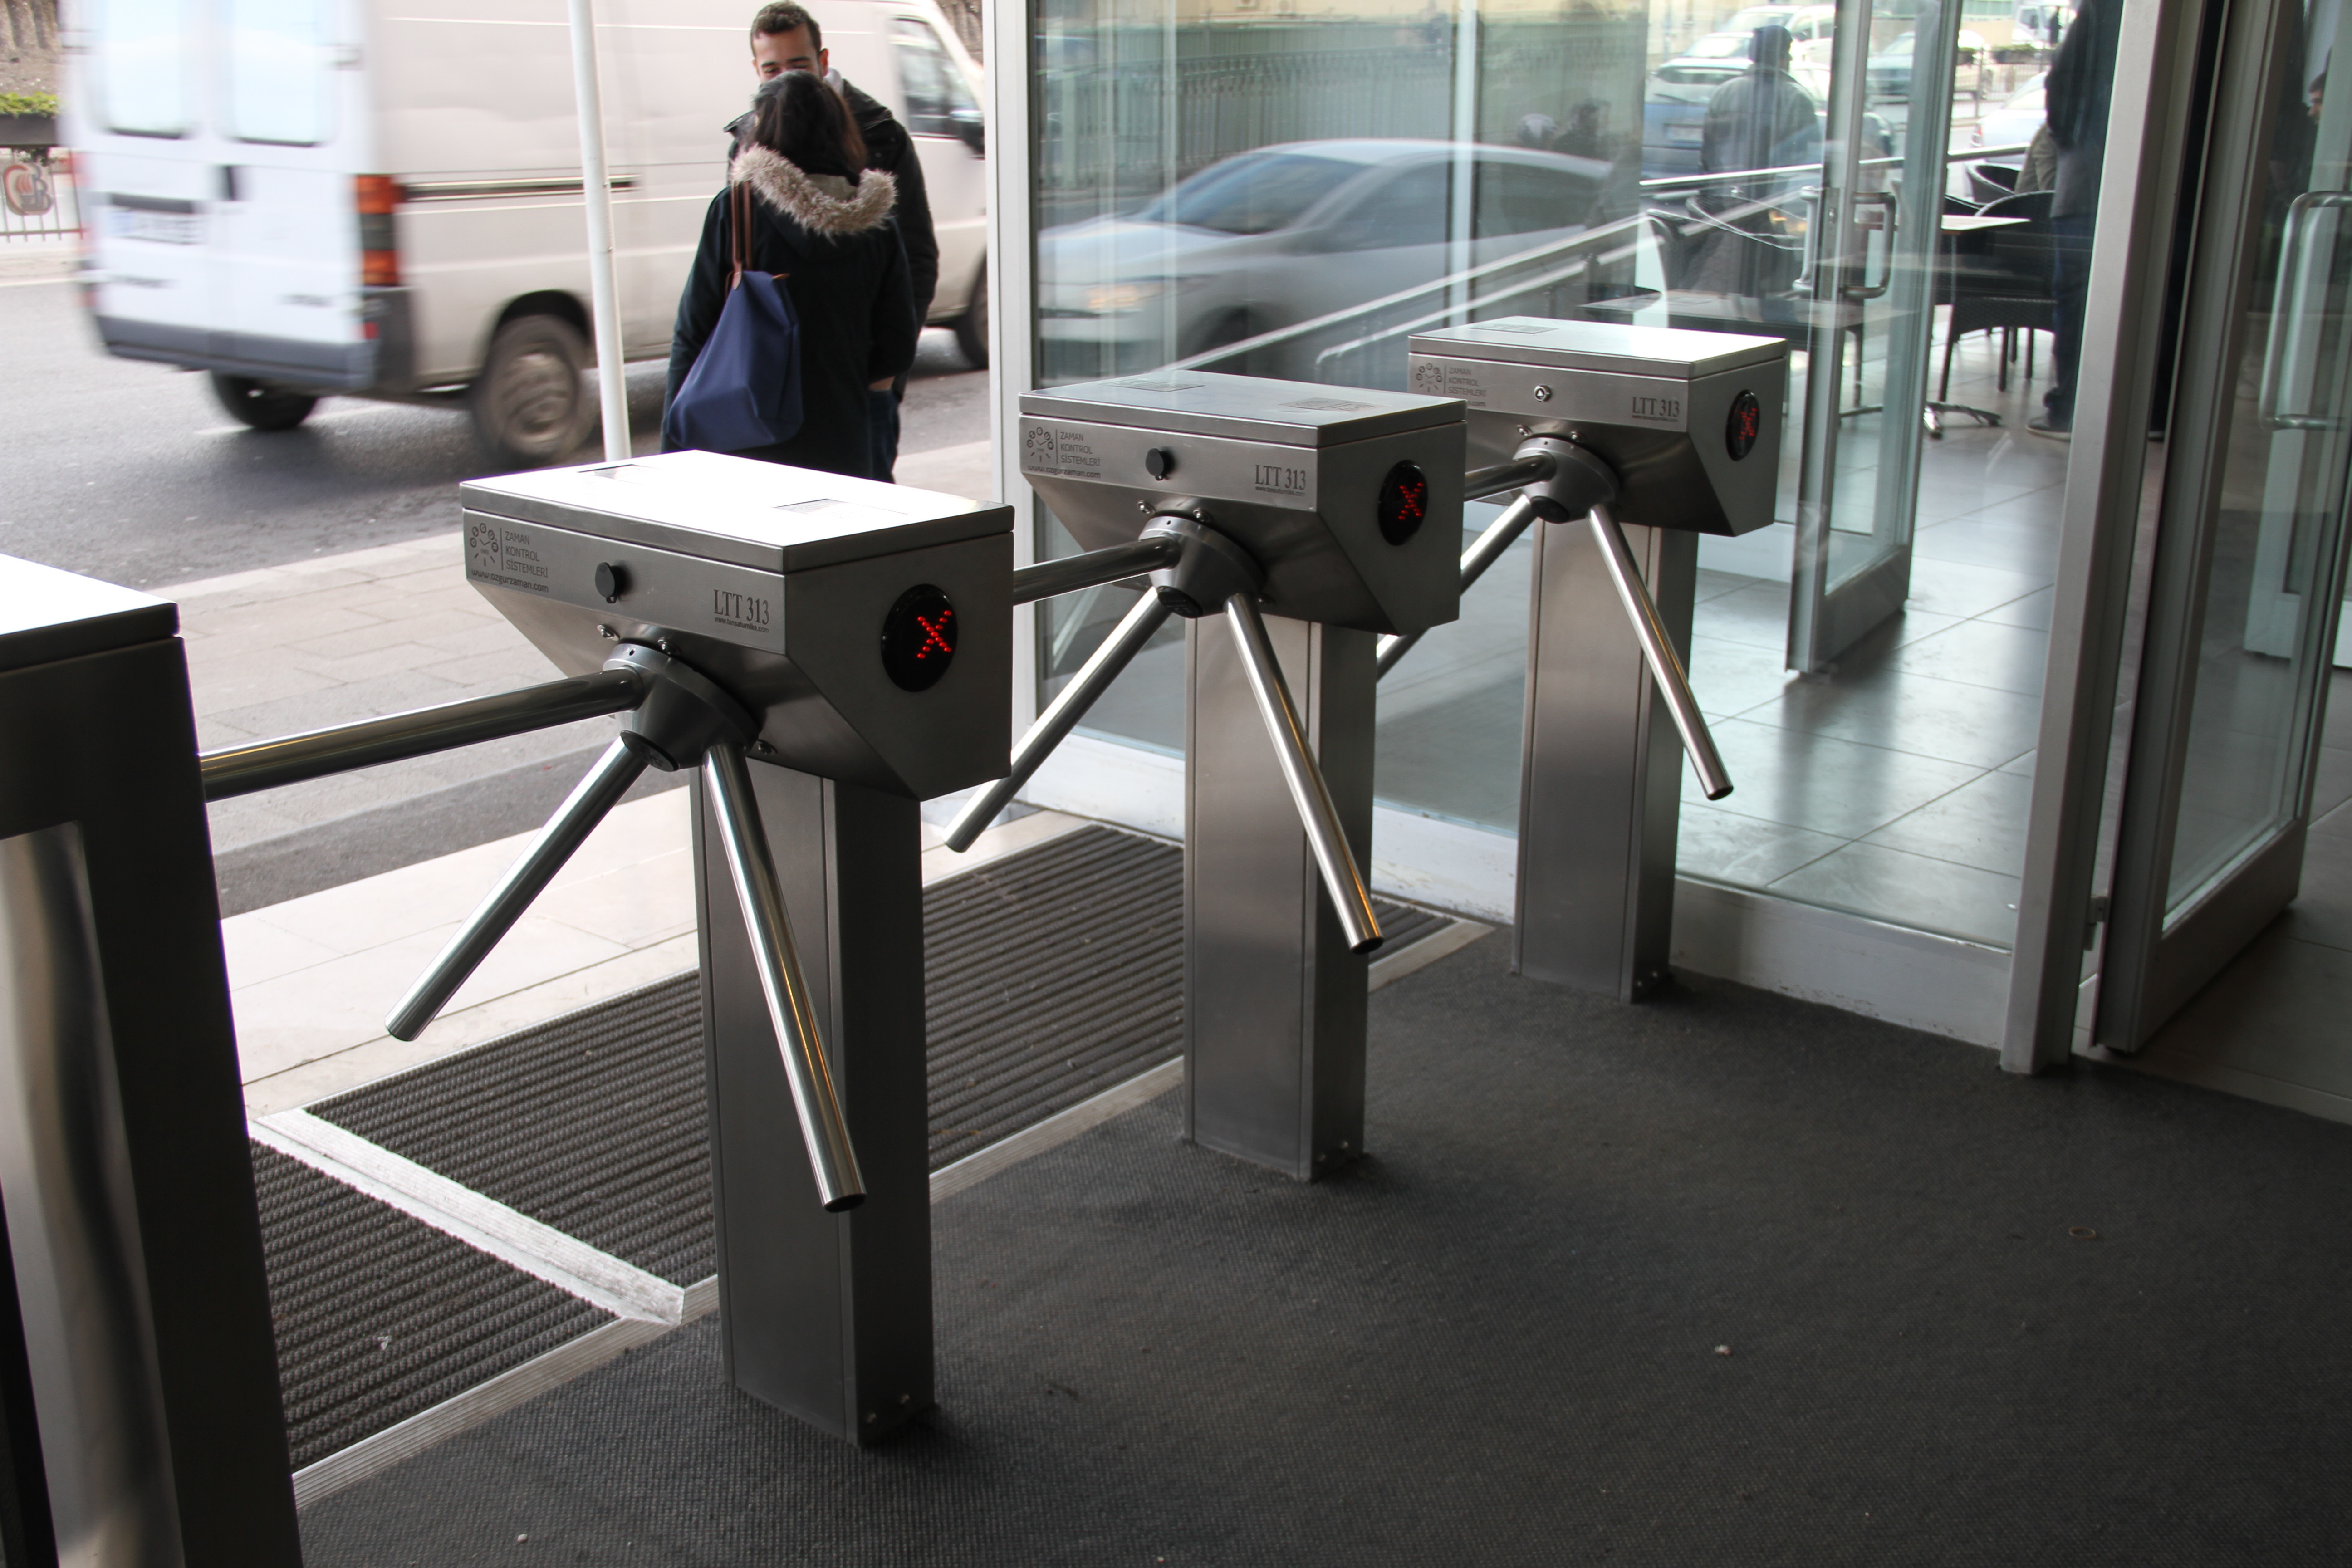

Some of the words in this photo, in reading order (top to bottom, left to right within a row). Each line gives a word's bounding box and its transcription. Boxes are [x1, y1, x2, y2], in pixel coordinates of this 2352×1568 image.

[1449, 377, 1479, 387] KONTROL
[1632, 397, 1657, 415] LTT
[1659, 399, 1680, 417] 313
[1060, 431, 1084, 441] ZAMAN
[1060, 443, 1093, 455] KONTROL
[1255, 464, 1282, 487] LTT
[1284, 468, 1306, 490] 313
[505, 530, 530, 545] ZAMAN
[505, 545, 540, 562] KONTROL
[506, 559, 549, 578] SİSTEMLERİ
[471, 569, 549, 593] www.ozgurzaman.com
[713, 589, 743, 619] LTT
[746, 596, 770, 625] 313
